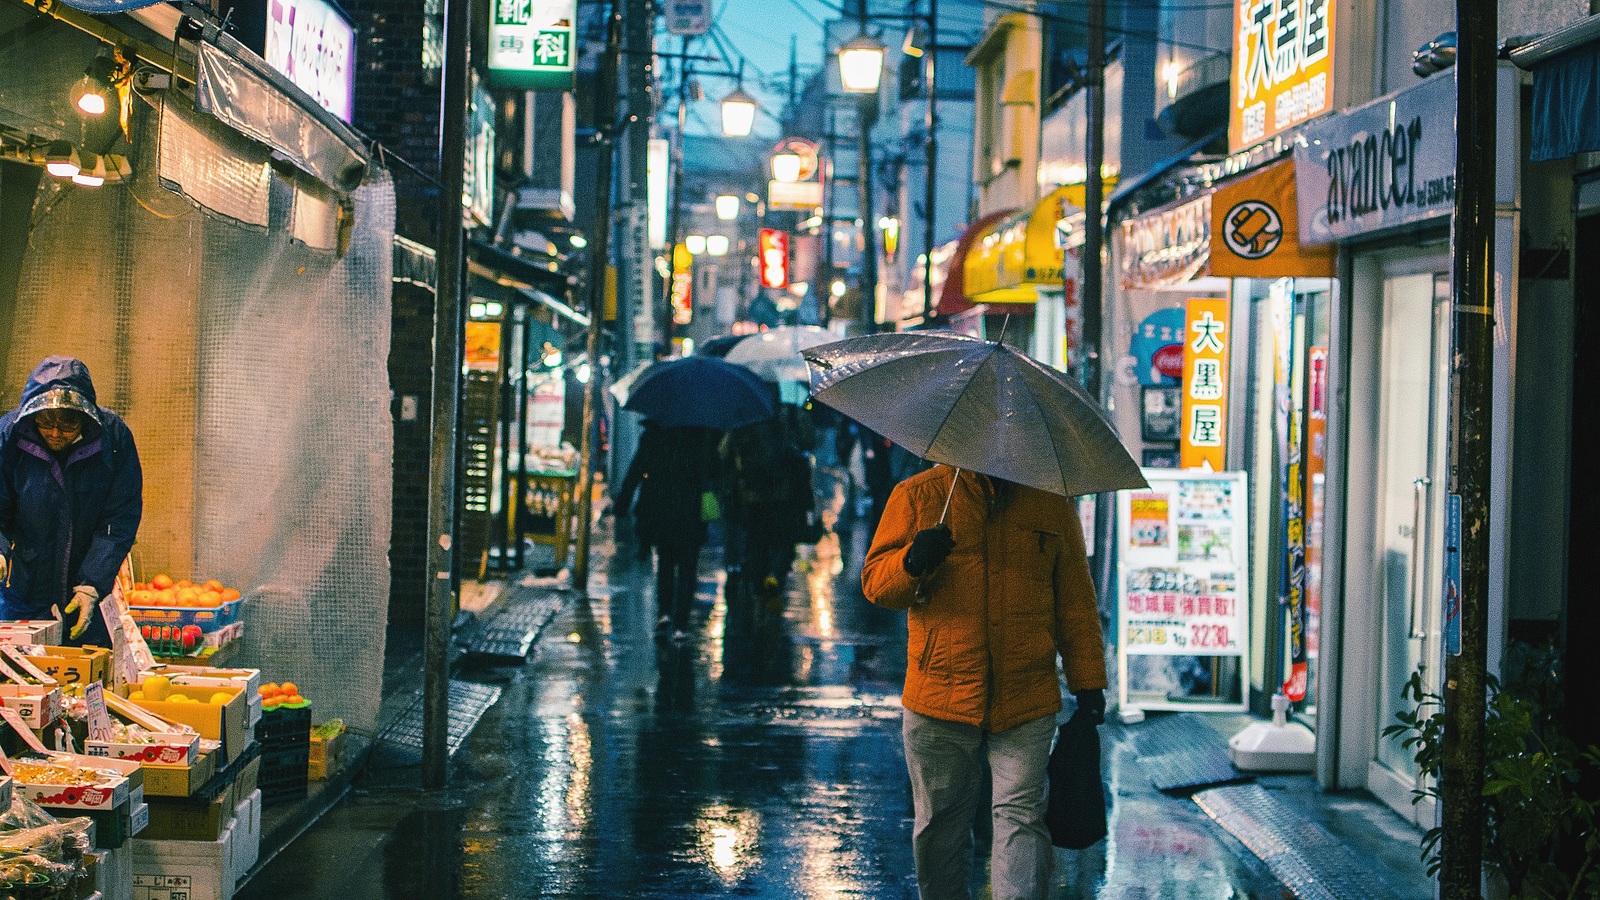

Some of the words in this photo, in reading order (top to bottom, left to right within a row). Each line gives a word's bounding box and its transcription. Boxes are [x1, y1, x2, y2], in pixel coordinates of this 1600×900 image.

[1327, 116, 1422, 224] avancer
[1190, 311, 1224, 447] 大黒屋
[1127, 627, 1166, 645] K18
